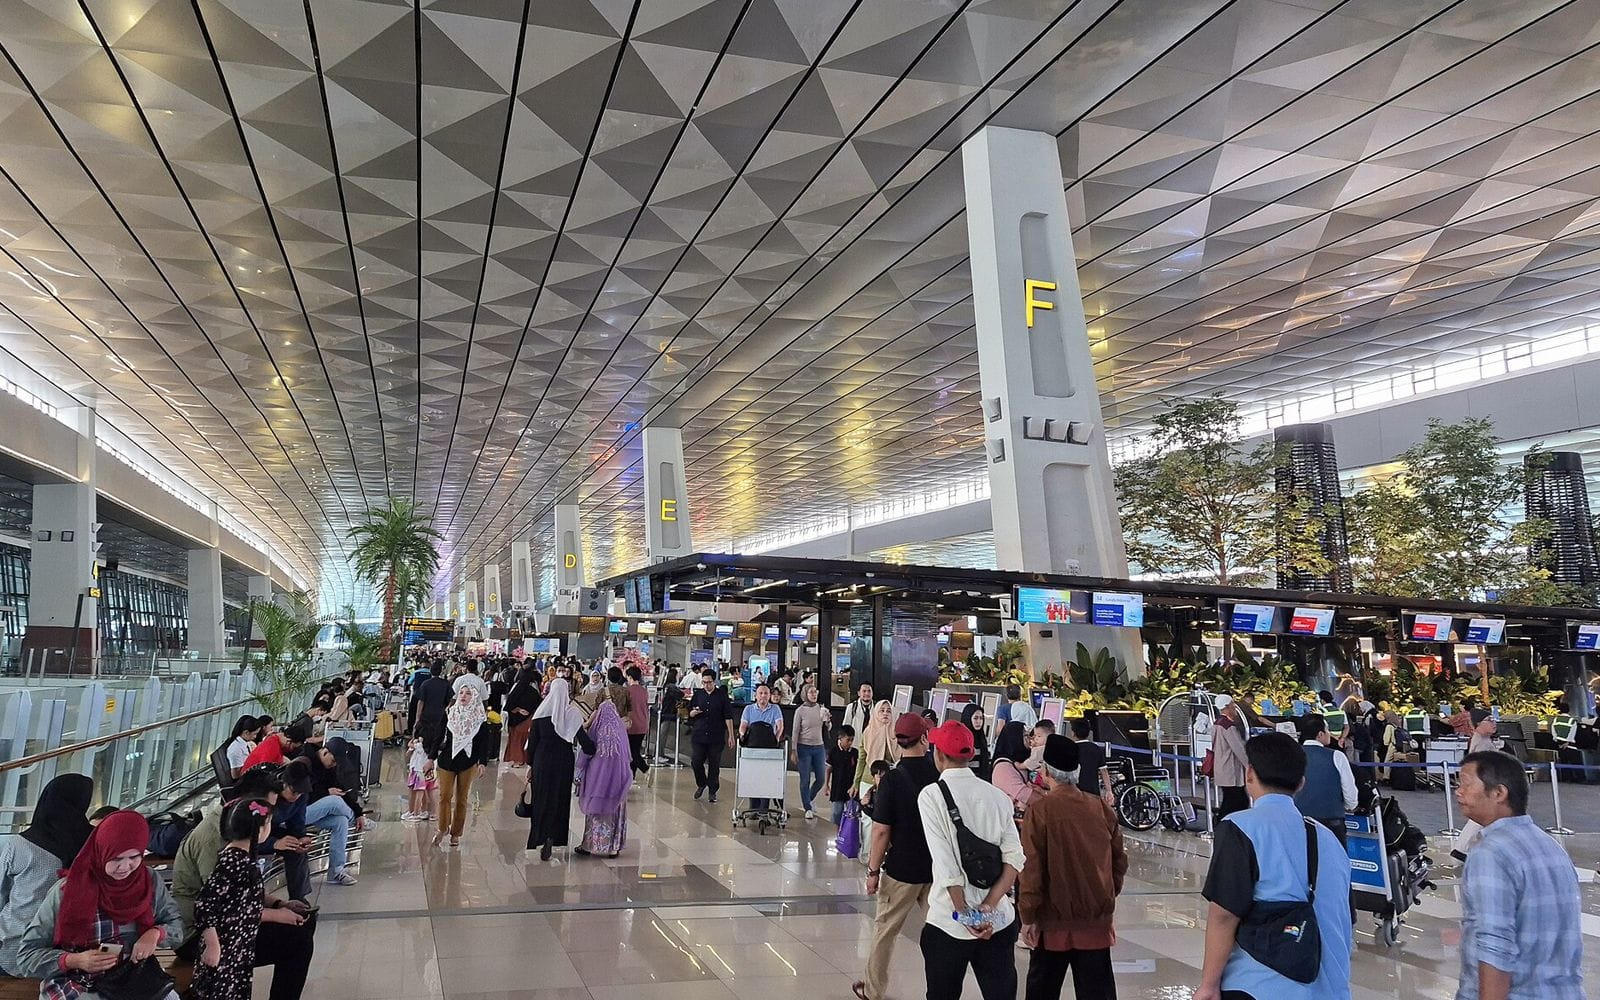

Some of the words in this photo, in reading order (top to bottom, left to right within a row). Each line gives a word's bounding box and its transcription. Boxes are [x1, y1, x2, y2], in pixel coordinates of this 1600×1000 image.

[1024, 278, 1057, 329] F
[661, 499, 677, 521] E
[565, 553, 577, 568] D
[489, 592, 497, 602] C
[468, 602, 475, 610] B
